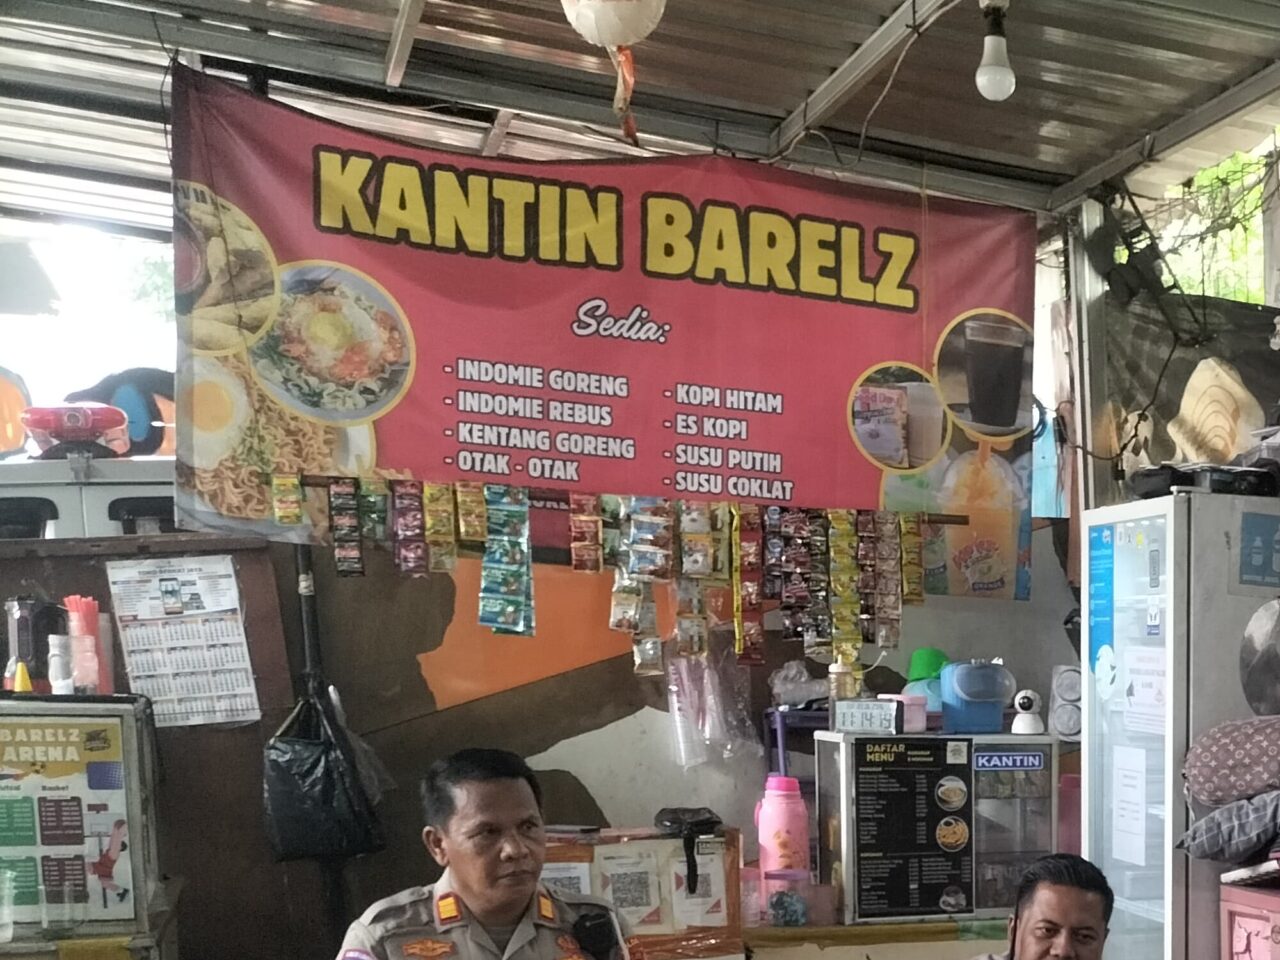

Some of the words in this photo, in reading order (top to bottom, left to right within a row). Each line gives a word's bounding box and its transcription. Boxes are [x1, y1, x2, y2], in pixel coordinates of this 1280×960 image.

[315, 147, 621, 269] KANTIN
[643, 195, 917, 310] BARELZ
[572, 298, 672, 345] Sedia:
[456, 358, 544, 389] INDOMIE
[548, 367, 628, 397] GORENG
[457, 390, 543, 421] INDOMIE
[548, 398, 613, 427] REBUS
[676, 383, 720, 410] KOPI
[725, 388, 783, 415] HITAM
[458, 422, 550, 452] KENTANG
[555, 430, 635, 459] GORENG
[676, 414, 697, 436] ES
[702, 417, 748, 440] KOPI
[458, 451, 510, 475] OTAK
[527, 458, 580, 482] OTAK
[675, 444, 722, 468] SUSU
[727, 448, 783, 473] PUTIH
[675, 471, 722, 495] SUSU
[727, 476, 794, 501] COKLAT
[4, 746, 80, 761] ARENA
[866, 744, 905, 752] DAFTAR
[866, 752, 895, 762] MENU
[977, 756, 1040, 767] KANTIN
